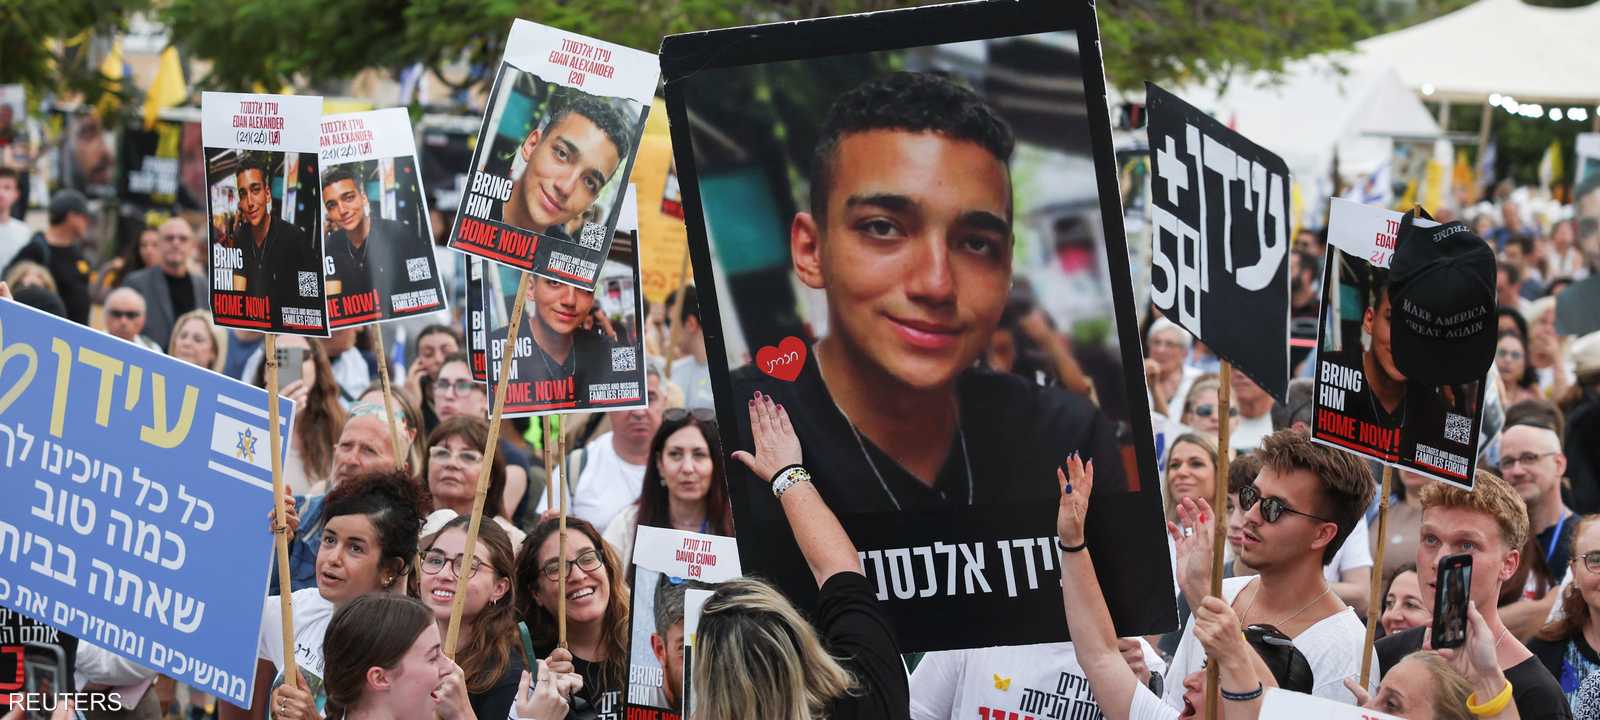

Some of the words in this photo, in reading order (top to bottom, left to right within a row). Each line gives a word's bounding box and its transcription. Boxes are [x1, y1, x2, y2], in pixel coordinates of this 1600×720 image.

[561, 38, 593, 58] אלכסנדר
[593, 47, 612, 63] עידן
[548, 50, 569, 67] EDAN
[569, 56, 615, 80] ALEXANDER
[568, 70, 585, 87] (20)
[232, 115, 248, 128] EDAN
[248, 115, 284, 130] ALEXANDER
[264, 101, 279, 116] עידן
[319, 135, 331, 147] AN
[332, 129, 374, 145] ALEXANDER
[470, 171, 513, 201] BRING
[464, 193, 493, 220] HIM
[1185, 122, 1287, 292] עידן
[458, 218, 498, 247] HOME
[500, 229, 540, 260] NOW!
[213, 243, 243, 269] BRING
[547, 258, 576, 275] FAMILIES
[575, 265, 597, 281] FORUM
[213, 268, 233, 291] HIM
[1151, 202, 1202, 341] 58
[213, 293, 243, 316] HOME
[245, 295, 271, 321] NOW!
[342, 288, 381, 316] NOW!
[1402, 298, 1431, 321] MAKE
[1435, 305, 1487, 326] AMERICA
[491, 337, 532, 360] BNG
[493, 359, 519, 381] HM
[1320, 360, 1363, 393] BRING
[49, 337, 200, 449] עידן
[492, 380, 532, 403] OME
[535, 375, 576, 401] NOW!
[589, 390, 617, 401] FAMILIES
[617, 388, 640, 399] FORUM
[1319, 386, 1346, 412] HIM
[1317, 408, 1357, 440] HOME
[1359, 421, 1400, 454] NOW!
[41, 440, 122, 499] חיכינו
[1415, 450, 1444, 469] FAMILIES
[1444, 460, 1468, 476] FORUM
[132, 466, 169, 513] כל
[31, 480, 97, 535] טוב
[177, 484, 215, 532] כל
[106, 509, 186, 570] כמה
[701, 540, 712, 552] דוד
[0, 520, 77, 588] בבית
[675, 549, 694, 563] DAVID
[695, 552, 717, 567] CUNIO
[997, 535, 1063, 598] ידן
[687, 563, 702, 579] (33)
[857, 541, 993, 601] אלכסנ
[15, 585, 48, 618] את
[87, 558, 206, 634] שאתה
[53, 600, 145, 658] ומחזירים
[150, 641, 247, 703] ממשיכים
[629, 663, 663, 688] BRING
[627, 684, 650, 706] HIM
[1019, 687, 1070, 720] הביתה
